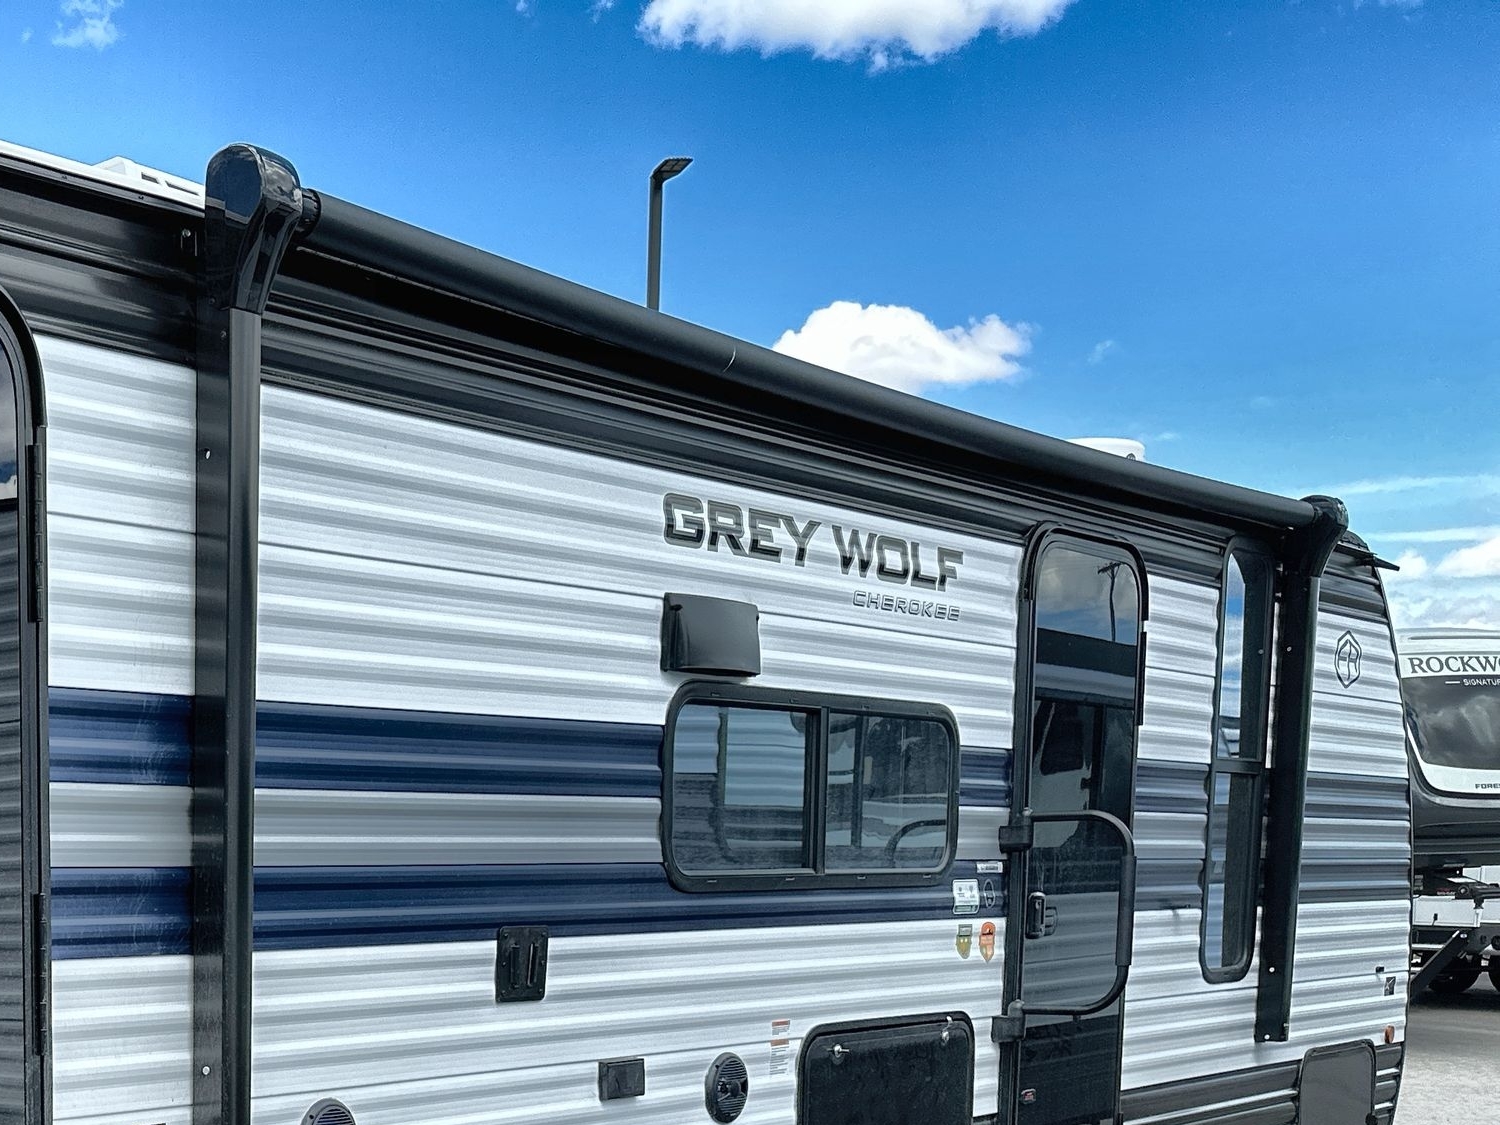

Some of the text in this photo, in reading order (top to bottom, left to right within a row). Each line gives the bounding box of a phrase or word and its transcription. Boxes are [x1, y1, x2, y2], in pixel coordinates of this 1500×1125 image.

[663, 492, 964, 592] GREY WOLF
[853, 590, 960, 622] CHEROKEE
[1408, 655, 1500, 674] ROCKW
[1474, 782, 1500, 790] FORE
